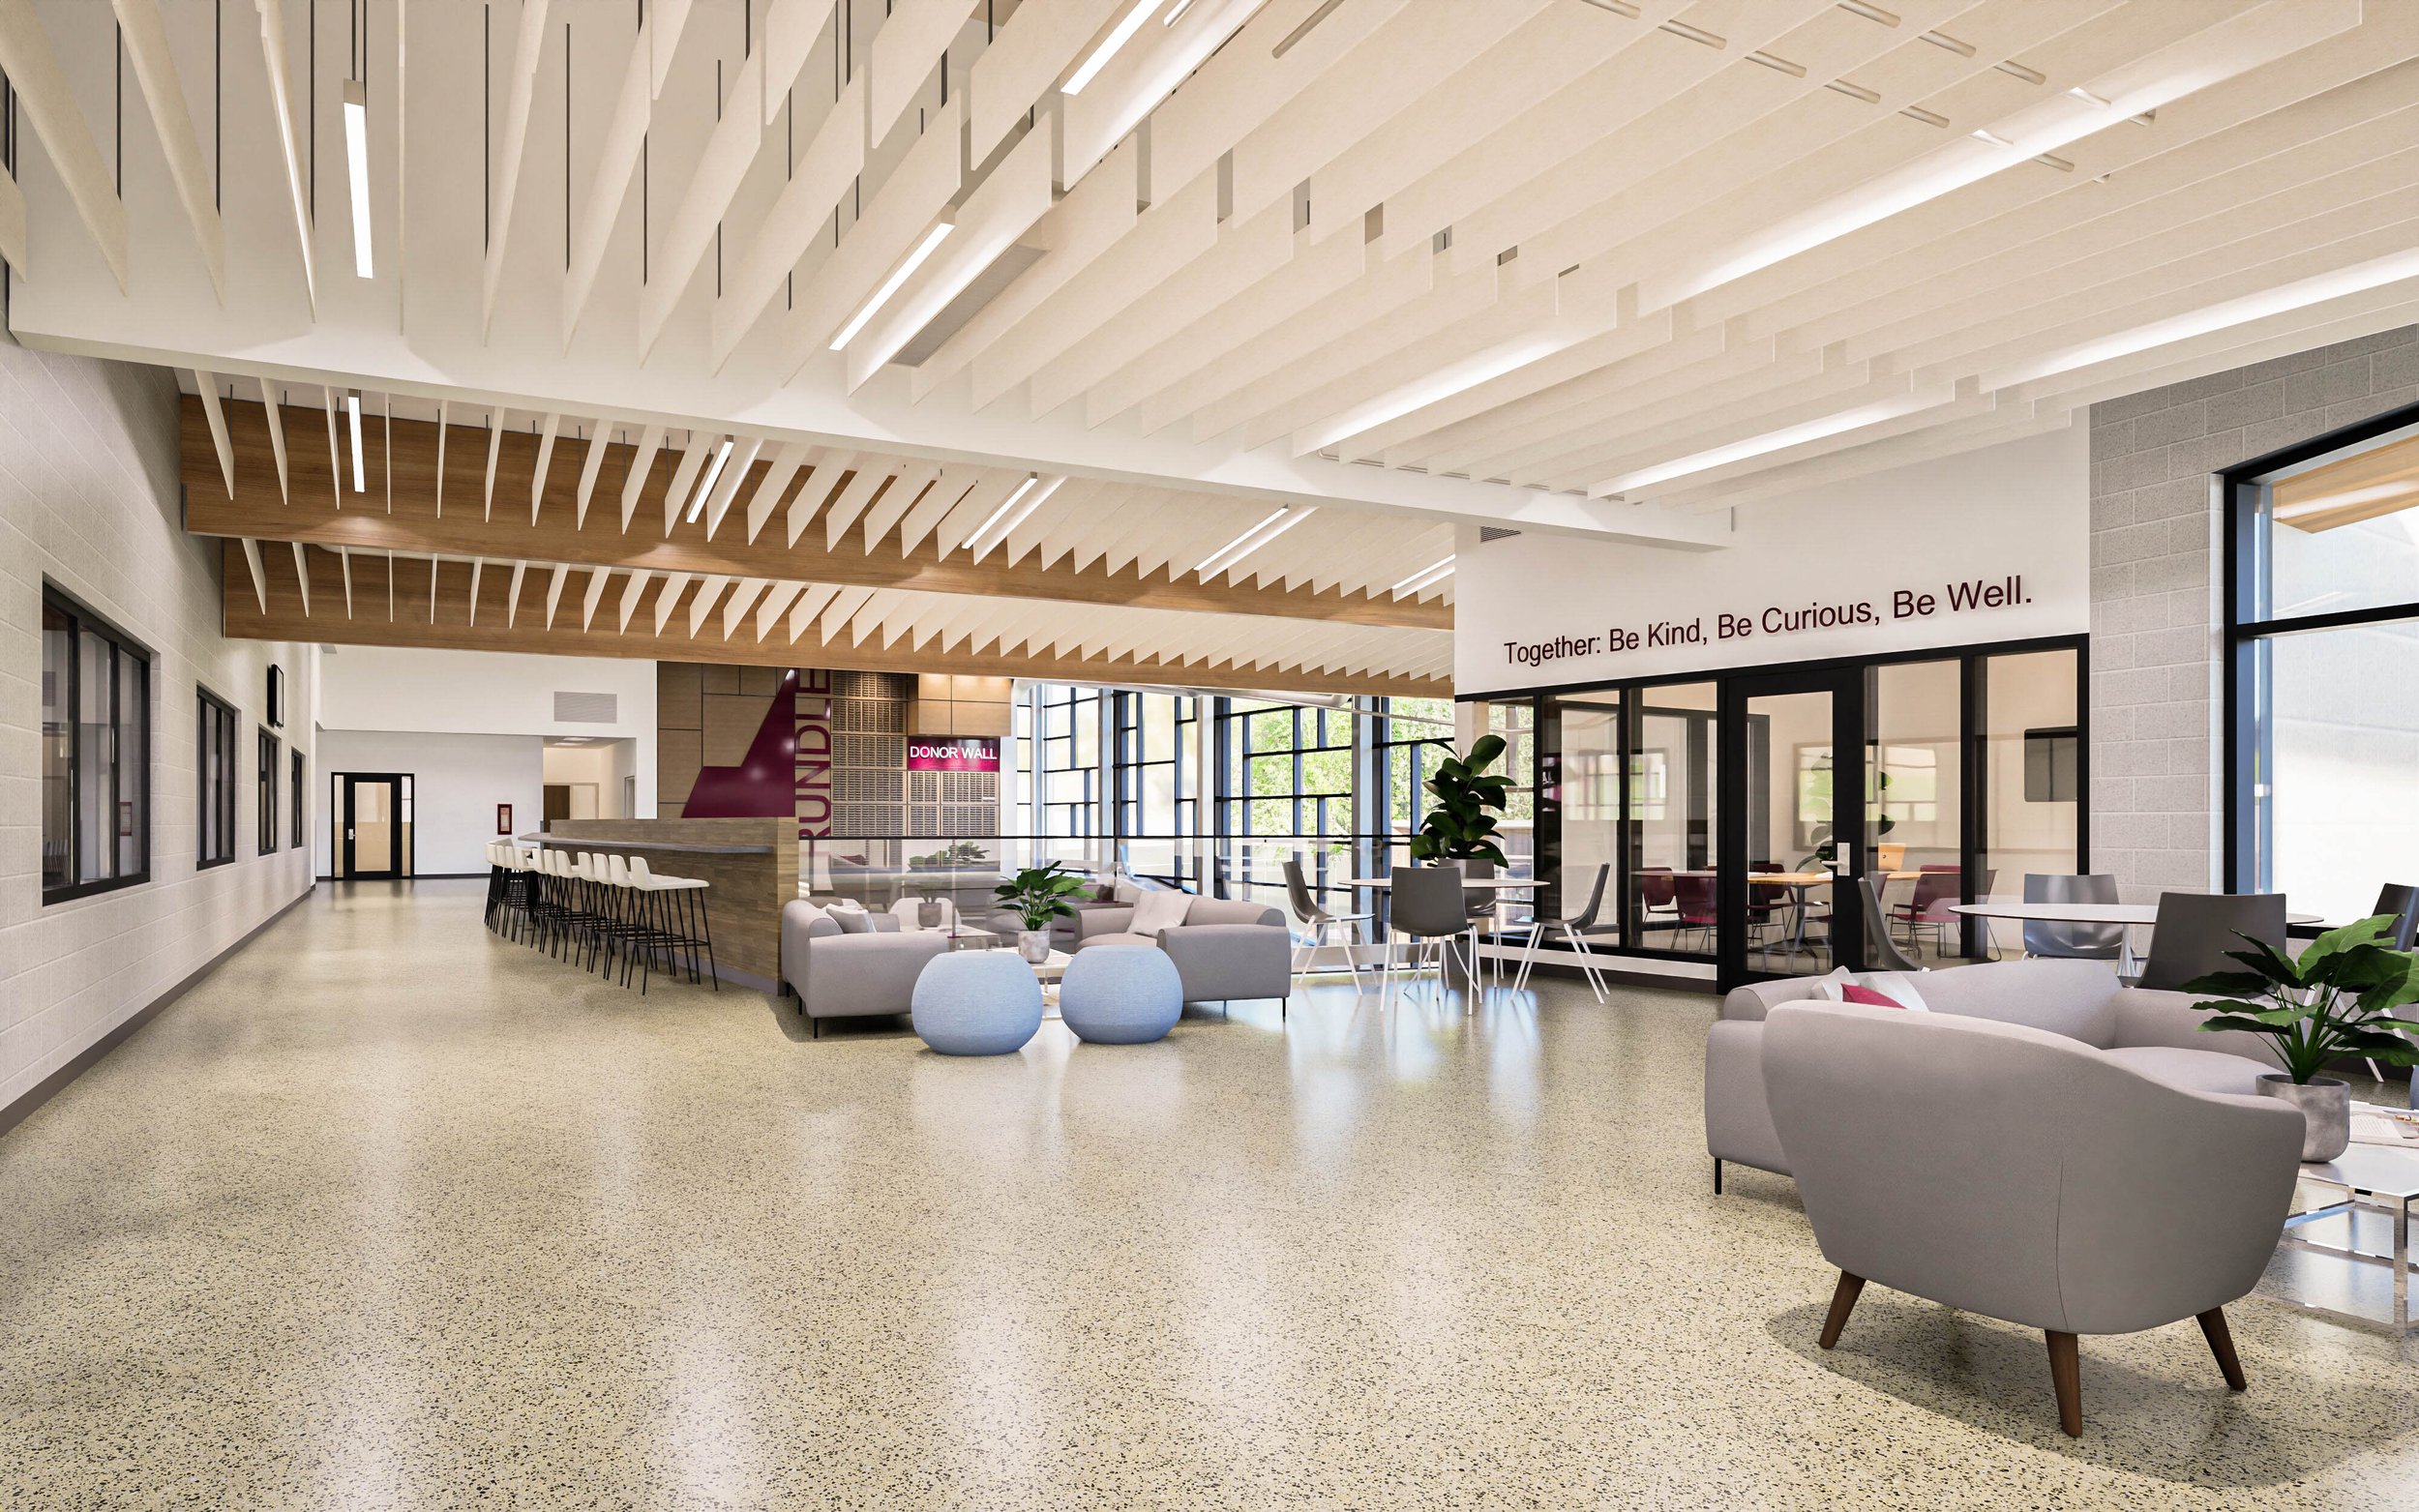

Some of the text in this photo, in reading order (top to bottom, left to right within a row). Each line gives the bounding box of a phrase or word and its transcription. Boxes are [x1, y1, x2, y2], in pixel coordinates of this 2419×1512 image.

[1503, 575, 2032, 667] Together: Be Kind, Be Curious, Be Well.
[910, 746, 958, 759] DONOR
[961, 748, 998, 760] WALL
